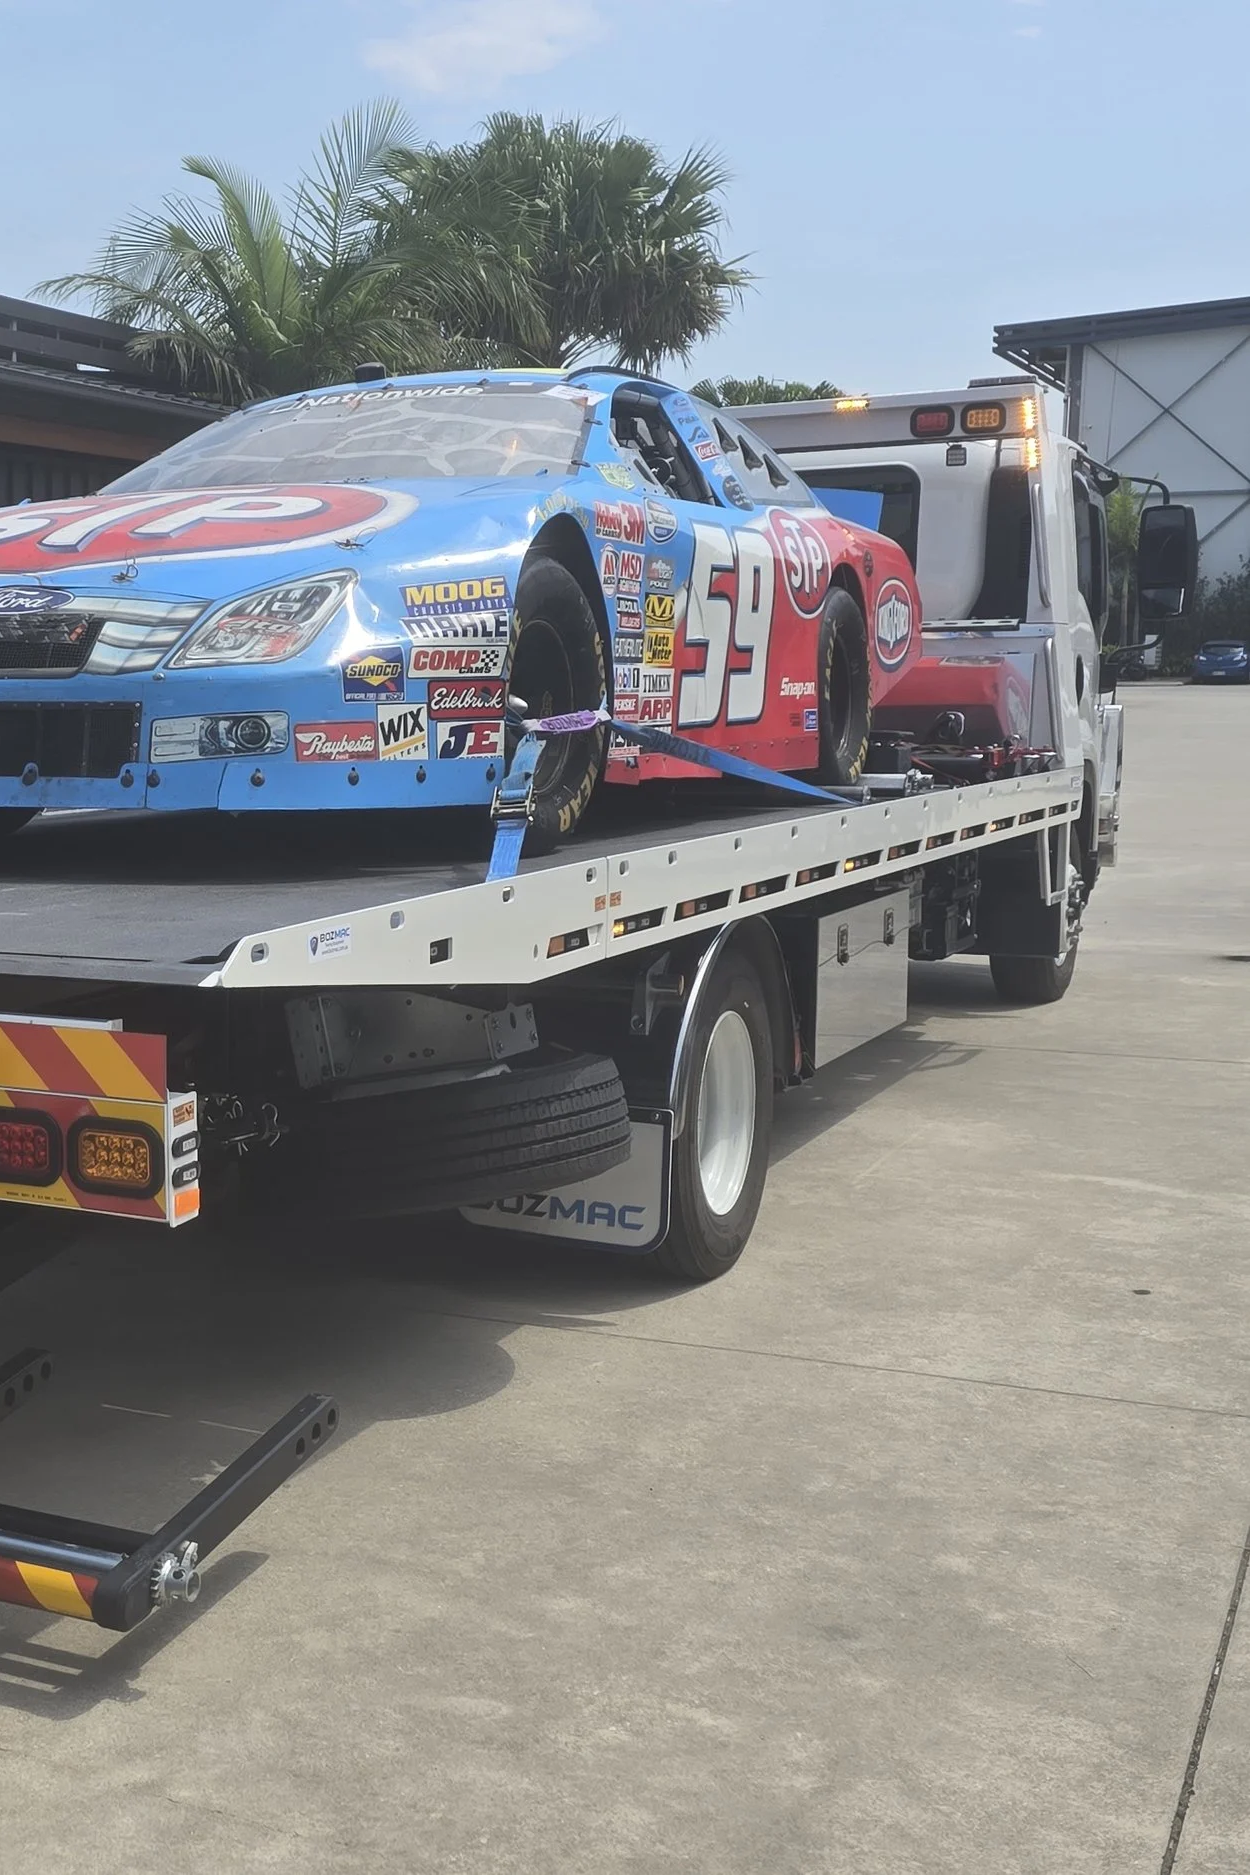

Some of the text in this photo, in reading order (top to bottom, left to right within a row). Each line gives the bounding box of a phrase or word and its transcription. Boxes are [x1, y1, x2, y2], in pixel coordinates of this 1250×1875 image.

[297, 385, 484, 409] Nationwide
[621, 503, 644, 543] 3M
[621, 552, 641, 580] MSD
[781, 519, 824, 596] STP
[406, 578, 505, 606] MOOG
[650, 581, 667, 589] POLE
[413, 599, 507, 616] CHASSIS PARTS
[404, 612, 507, 638] MAHLE
[678, 520, 774, 727] 59
[654, 634, 669, 647] Auto
[349, 664, 400, 677] SUNOCO
[414, 650, 481, 671] COMP
[459, 666, 492, 674] CAMS
[643, 674, 671, 693] TIMKEN
[780, 677, 816, 700] Snap-on
[640, 699, 671, 720] ARP
[379, 707, 425, 746] WIX
[440, 723, 501, 759] JE
[319, 927, 350, 943] BOZMAC
[468, 1193, 646, 1231] OZMAC
